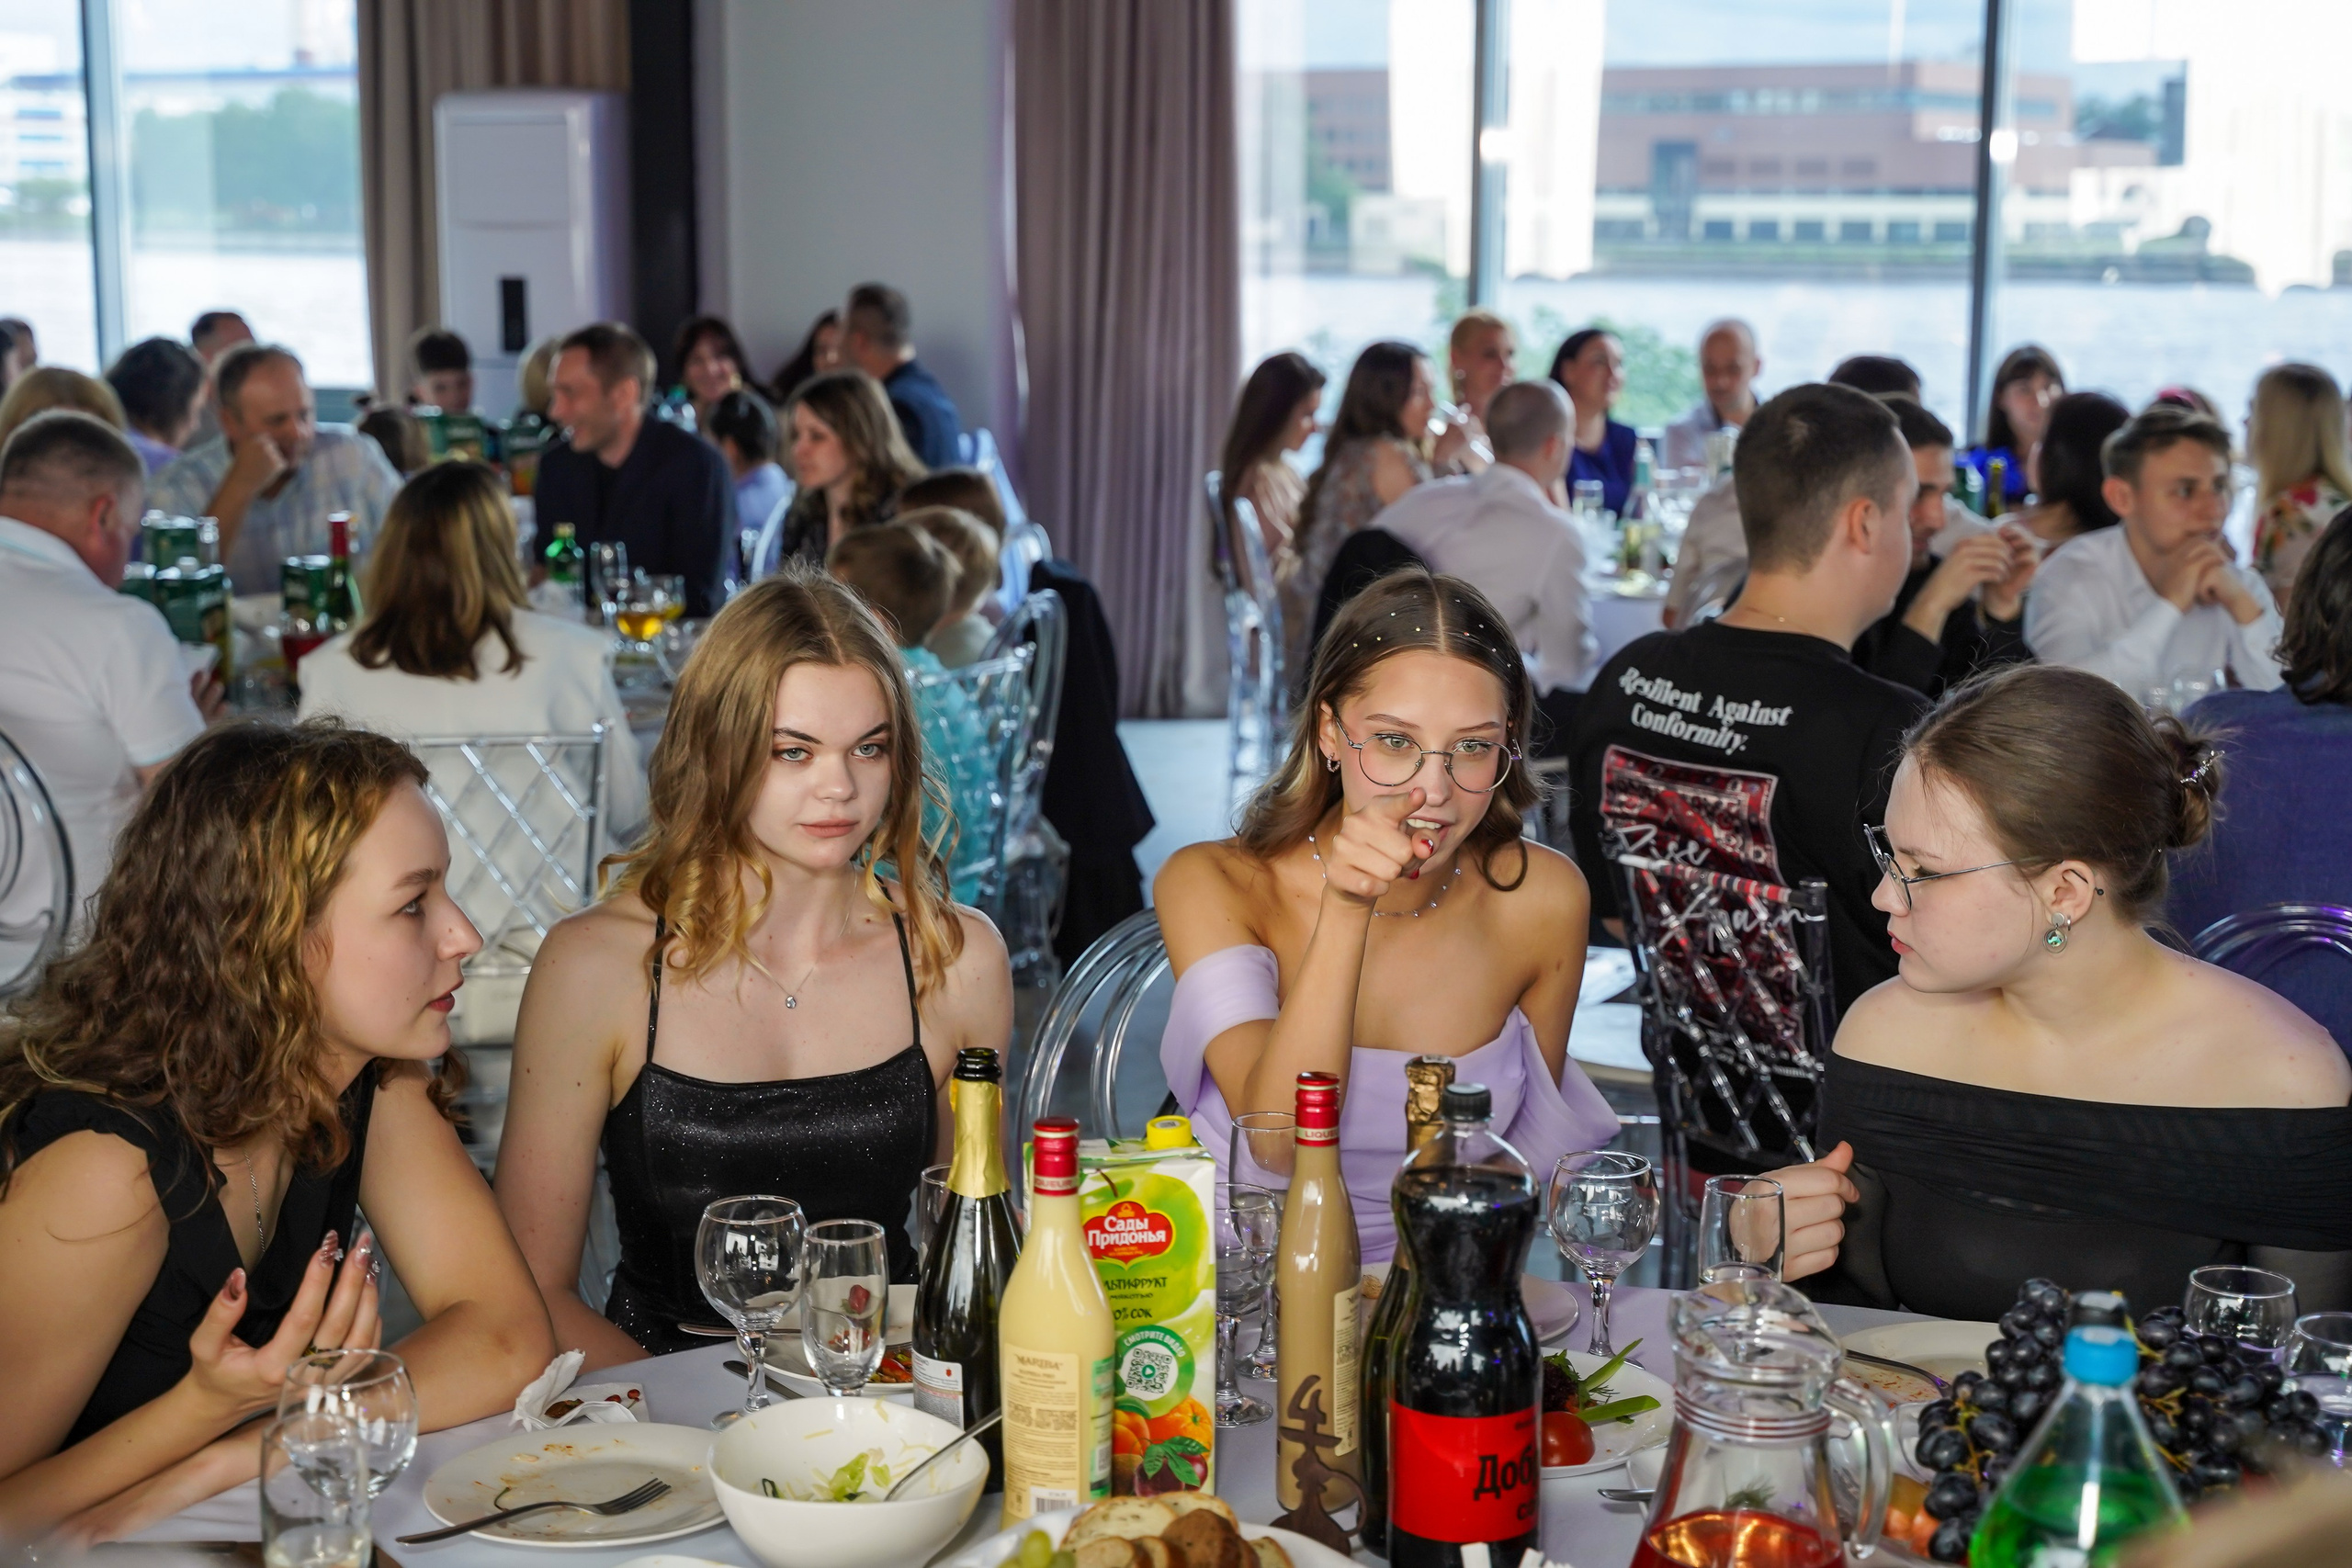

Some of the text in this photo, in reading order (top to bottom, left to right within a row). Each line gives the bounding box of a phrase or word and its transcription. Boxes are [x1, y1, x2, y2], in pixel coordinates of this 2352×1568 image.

[1619, 666, 1793, 727] Resilient Against
[1631, 702, 1748, 756] Conformity.
[1035, 1178, 1073, 1188] QUEUR
[1103, 1215, 1148, 1232] Сады
[1088, 1230, 1166, 1249] Придонья
[1104, 1277, 1168, 1291] ЛЬТИФРУКТ
[1130, 1308, 1153, 1320] СОК
[1124, 1330, 1186, 1358] СМОТРИТЕ ВИДЕО
[1473, 1444, 1539, 1501] Доб
